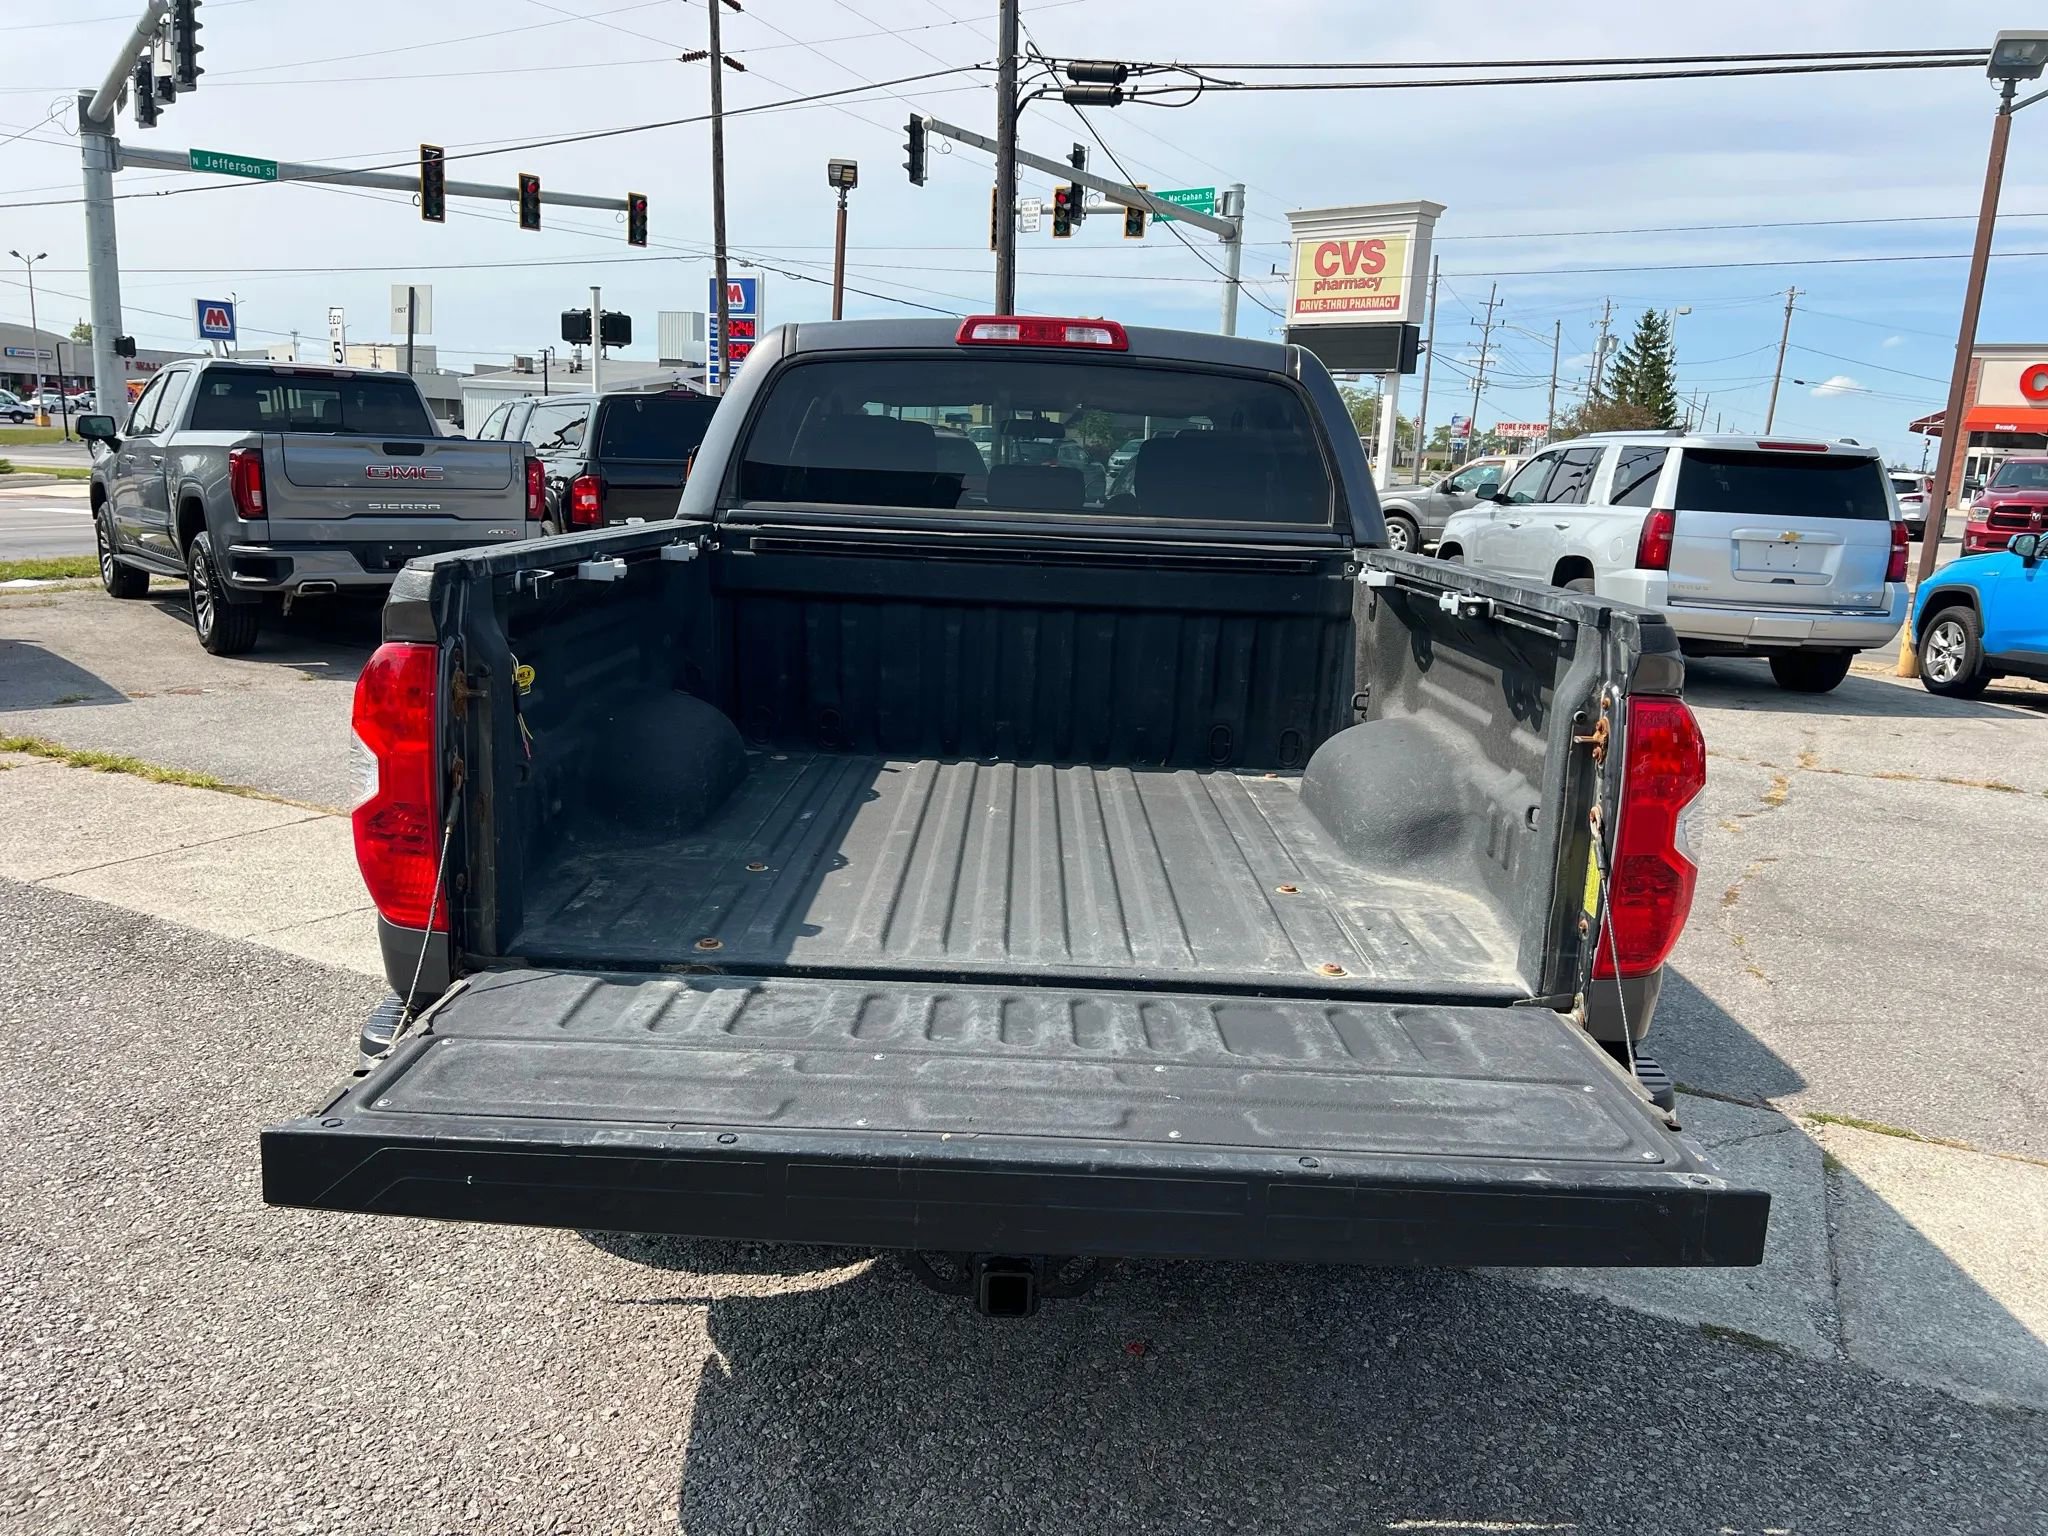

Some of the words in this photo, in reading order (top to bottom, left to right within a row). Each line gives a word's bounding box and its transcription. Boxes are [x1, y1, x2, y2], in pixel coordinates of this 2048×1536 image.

[192, 156, 199, 166] N
[205, 156, 260, 174] Jefferson
[266, 167, 275, 176] St
[1182, 192, 1203, 201] Gahan
[1205, 191, 1213, 200] St
[1314, 239, 1386, 277] CVS
[1314, 276, 1383, 294] pharmacy
[1300, 299, 1347, 311] DRIVE-THRU
[1350, 297, 1396, 309] PHARMACY
[206, 308, 228, 326] M
[366, 465, 444, 480] GMC
